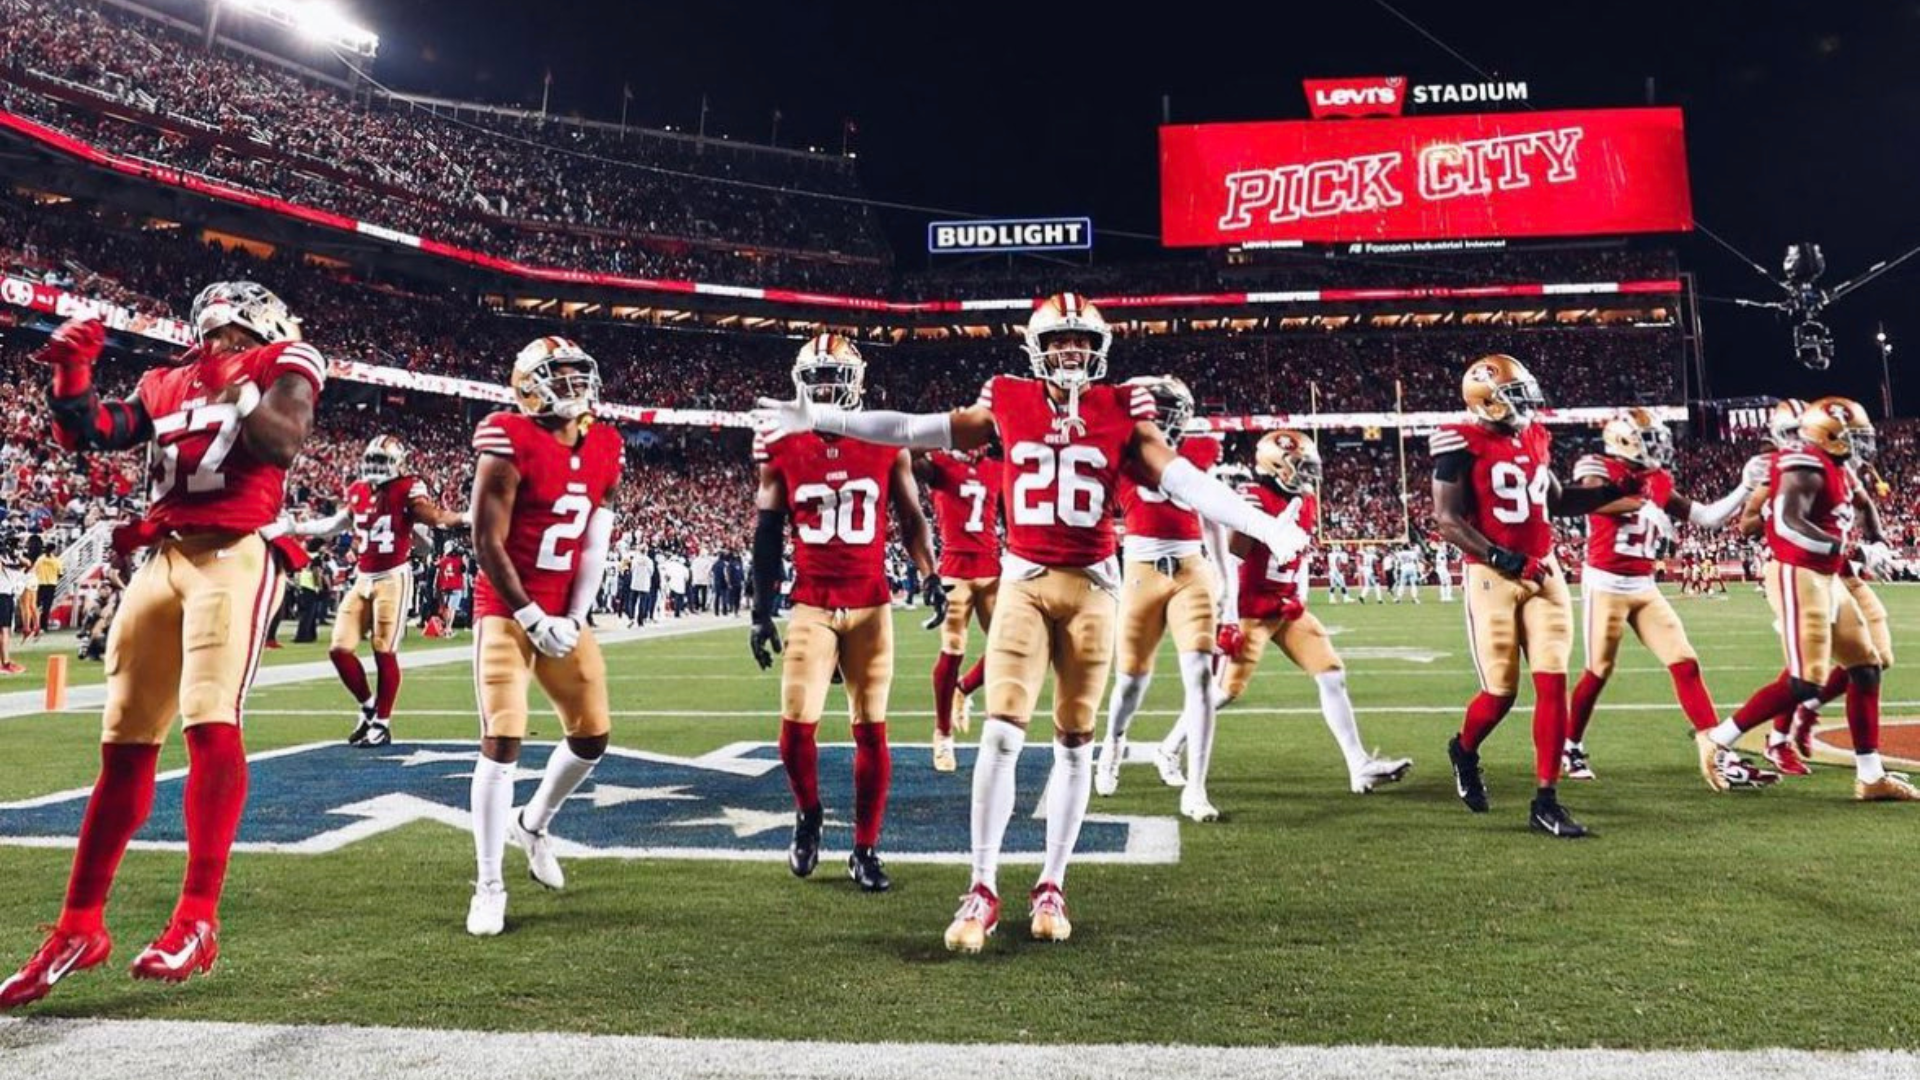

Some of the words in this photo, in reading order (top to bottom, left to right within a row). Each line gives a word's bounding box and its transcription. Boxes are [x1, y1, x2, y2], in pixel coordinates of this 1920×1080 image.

[1413, 82, 1528, 103] STADIUM
[1218, 152, 1403, 231] PICK
[1417, 127, 1583, 201] CITY
[1366, 242, 1411, 253] Foxconn
[1413, 240, 1463, 251] Industrial
[151, 403, 243, 503] 57
[1010, 441, 1108, 528] 26
[794, 477, 880, 545] 30
[959, 483, 987, 533] 7
[1491, 461, 1550, 524] 94
[354, 514, 395, 554] 54
[535, 494, 592, 572] 2
